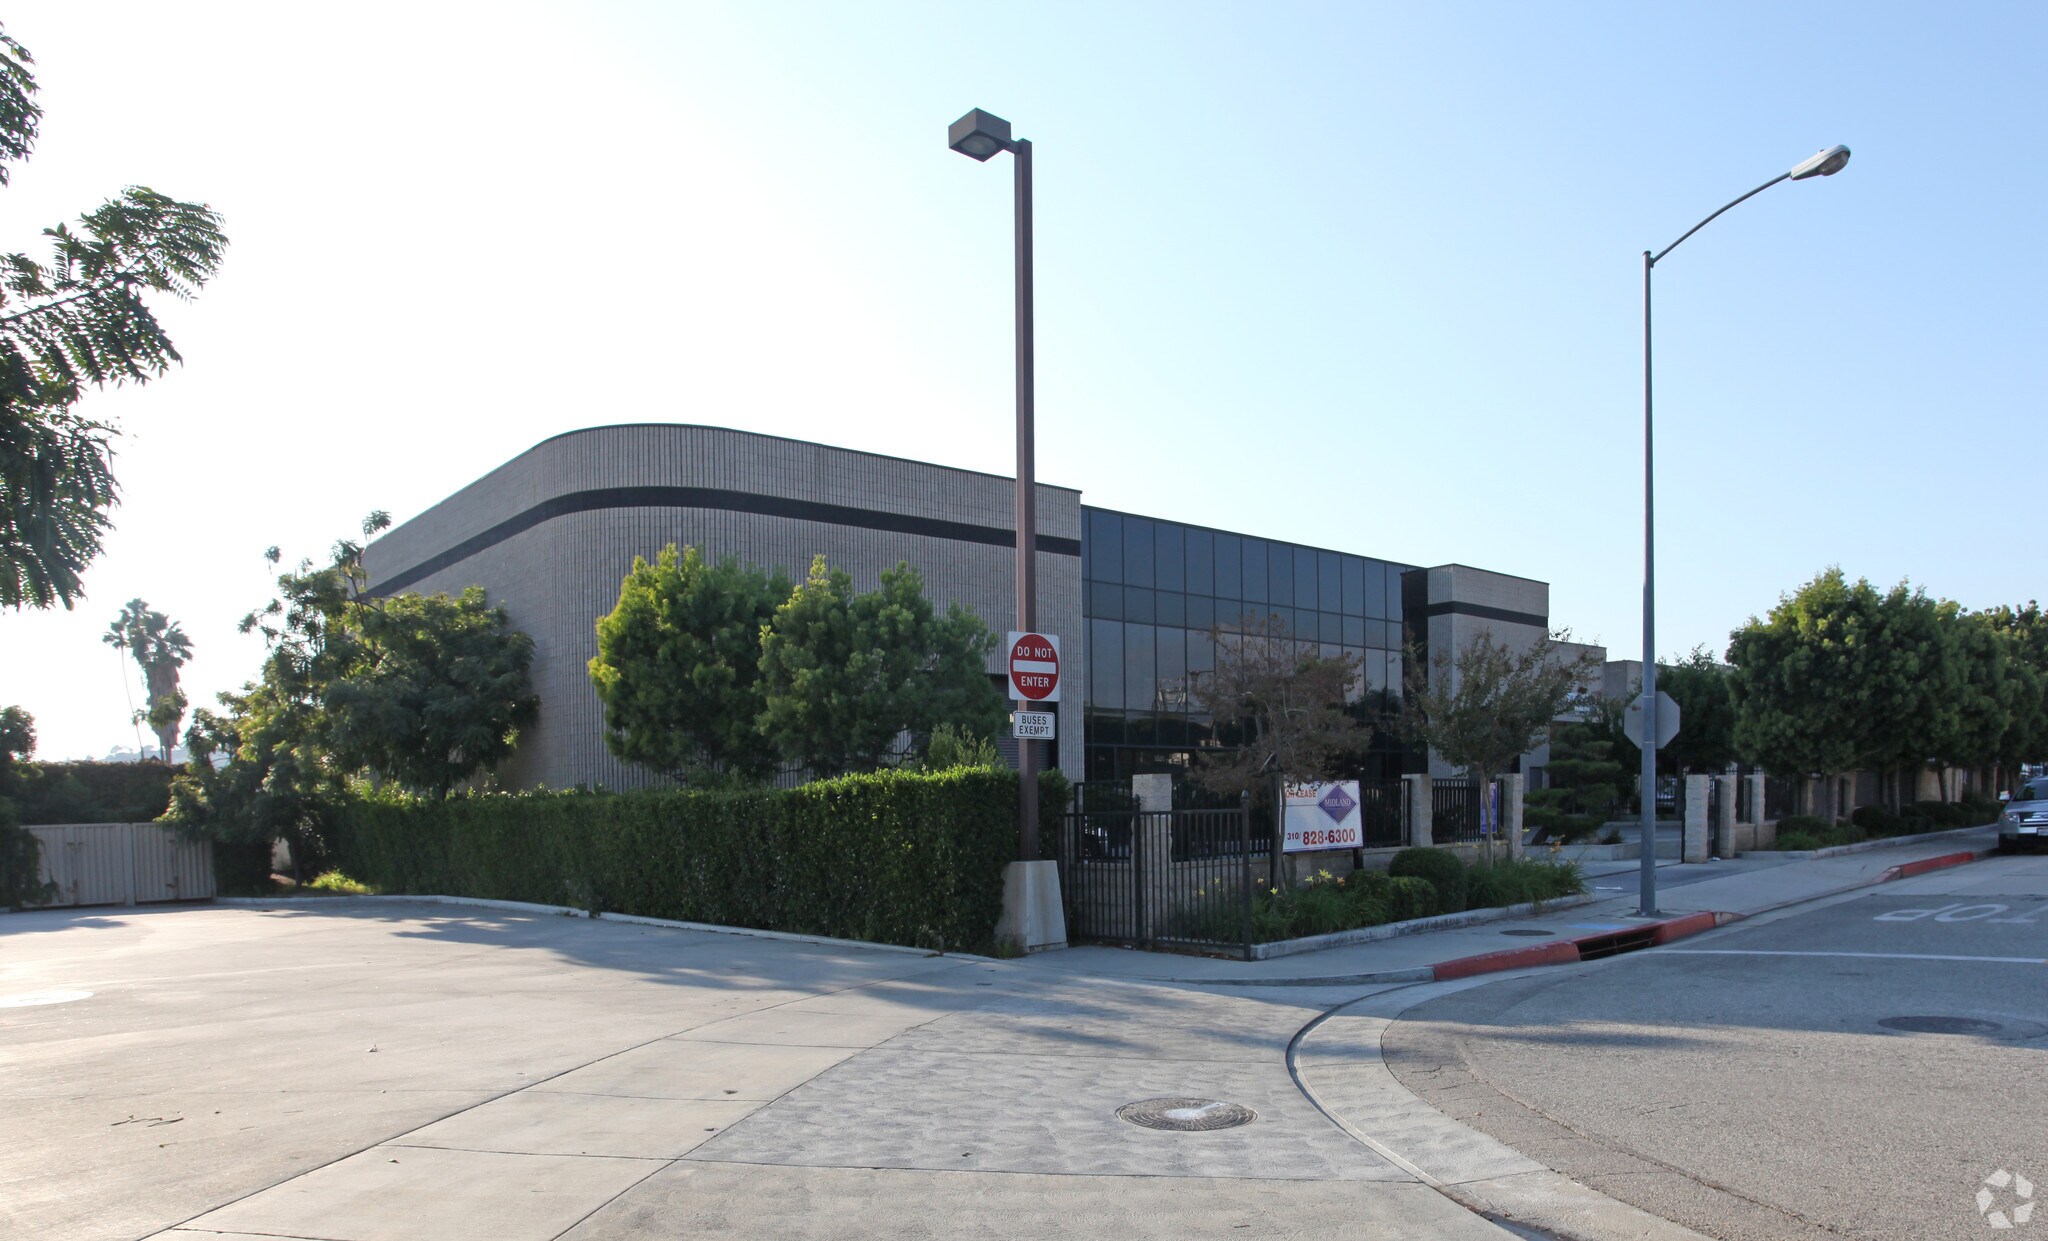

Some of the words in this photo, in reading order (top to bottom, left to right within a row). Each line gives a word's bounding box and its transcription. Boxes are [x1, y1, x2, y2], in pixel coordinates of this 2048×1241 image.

[1017, 646, 1030, 657] DO
[1034, 647, 1052, 658] NOT
[1021, 676, 1049, 687] ENTER
[1021, 715, 1047, 725] BUSES
[1019, 725, 1050, 736] EXEMPT
[1285, 789, 1295, 799] OR
[1324, 798, 1351, 807] MIDLAND
[1873, 903, 2048, 923] TOP
